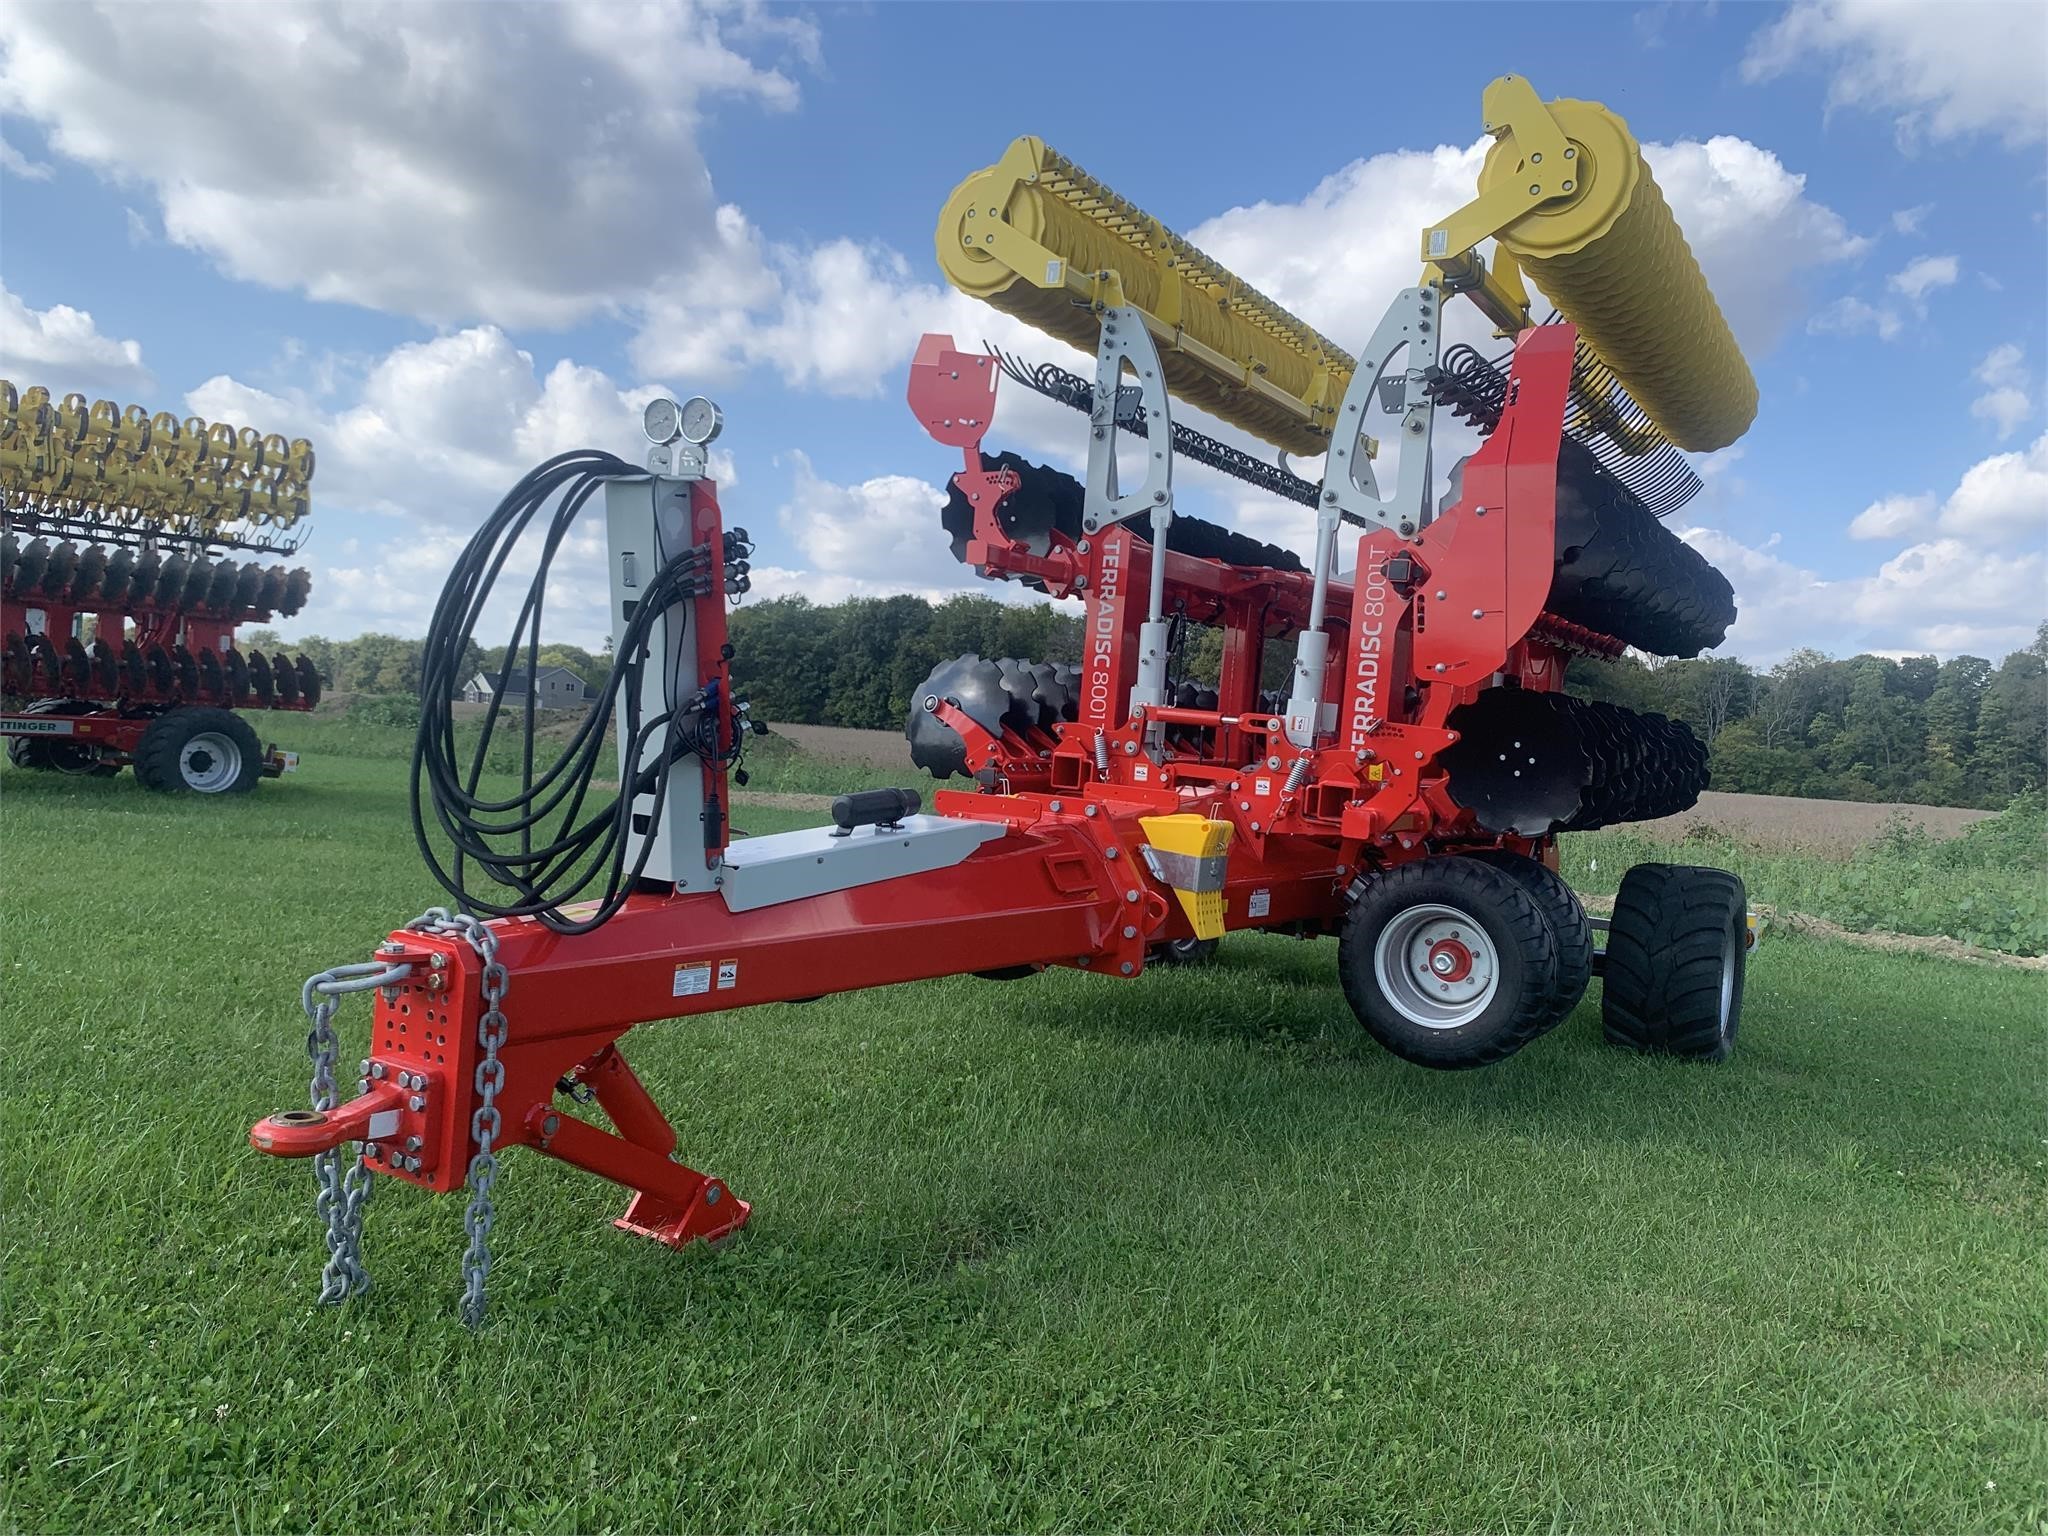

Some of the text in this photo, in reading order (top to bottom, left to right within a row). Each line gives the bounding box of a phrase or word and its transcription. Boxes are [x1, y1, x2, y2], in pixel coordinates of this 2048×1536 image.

[1093, 539, 1121, 668] TERRADISC
[1350, 544, 1387, 752] ERRADISC 8001T
